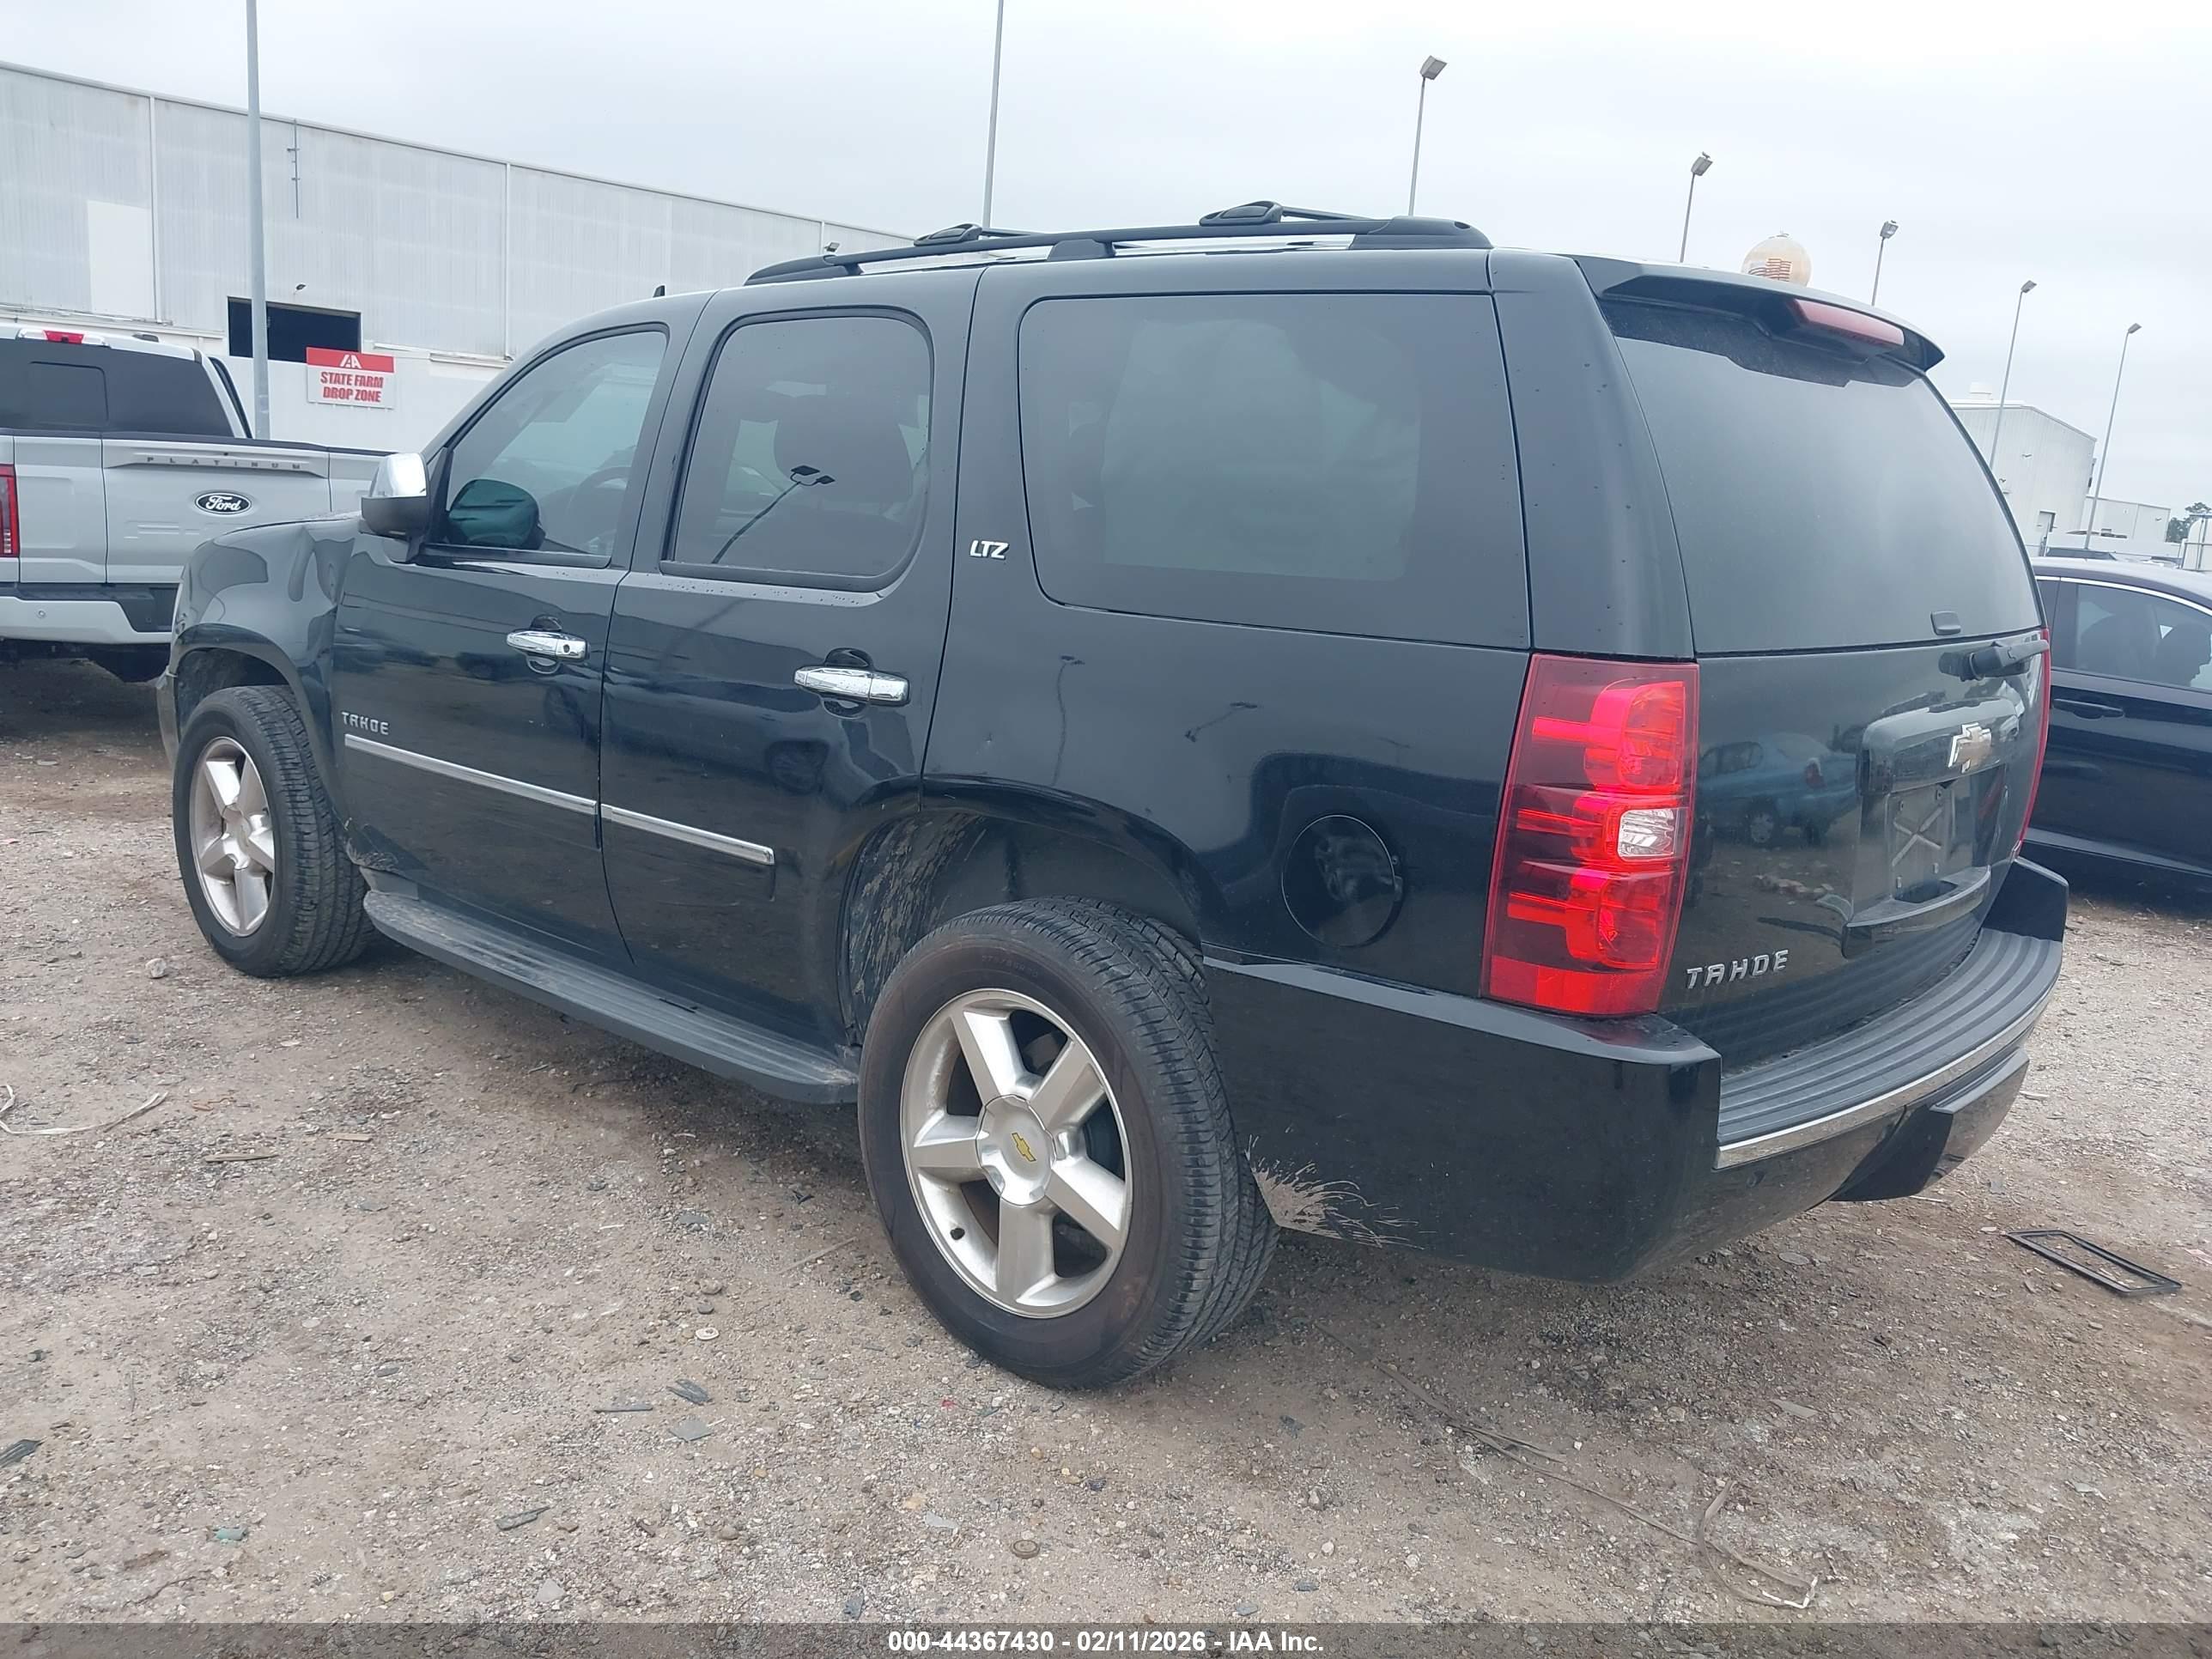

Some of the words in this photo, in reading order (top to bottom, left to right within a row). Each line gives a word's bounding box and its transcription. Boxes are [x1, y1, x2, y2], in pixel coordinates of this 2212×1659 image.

[320, 372, 353, 386] STATE
[354, 374, 384, 388] FARM
[323, 386, 353, 400] DROP
[355, 389, 381, 402] ZONE
[146, 457, 301, 470] PLATINUM
[205, 494, 241, 512] Ford
[969, 540, 1009, 560] LTZ
[341, 711, 389, 735] TAHOE
[1686, 949, 1789, 989] TAHOE
